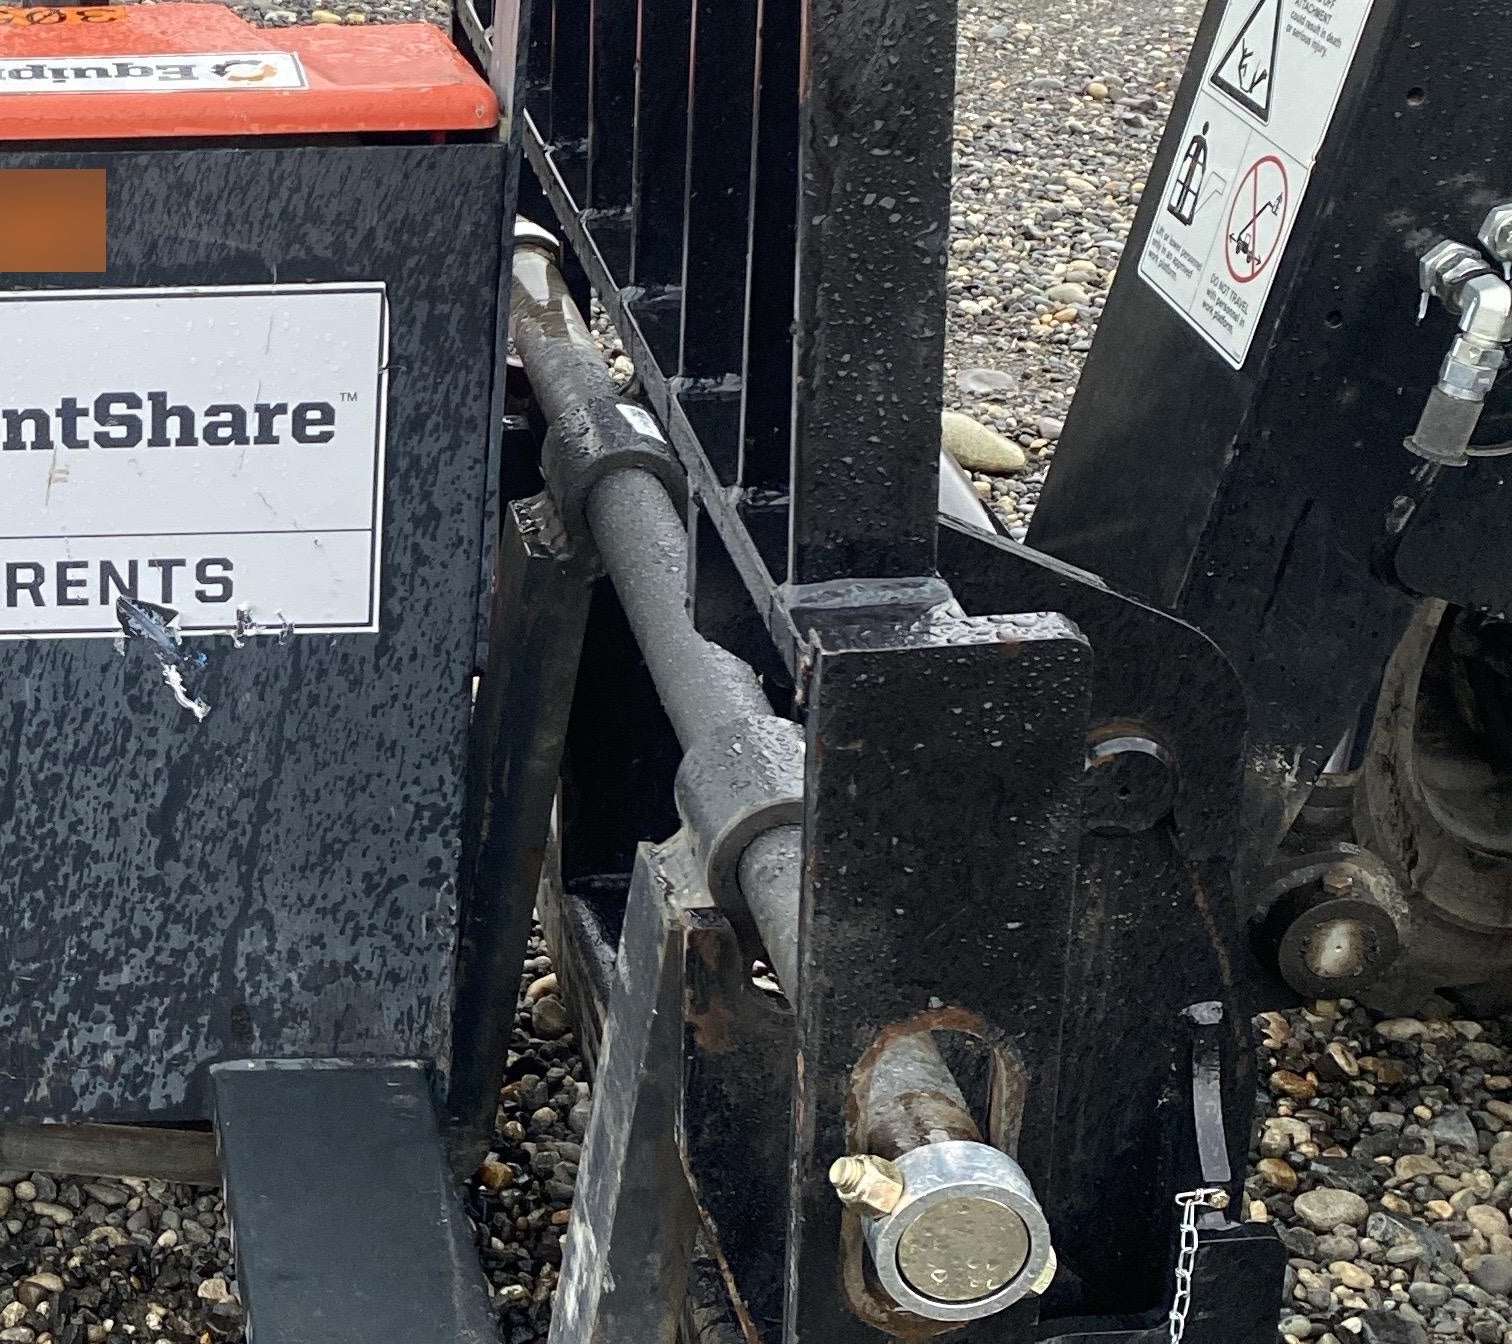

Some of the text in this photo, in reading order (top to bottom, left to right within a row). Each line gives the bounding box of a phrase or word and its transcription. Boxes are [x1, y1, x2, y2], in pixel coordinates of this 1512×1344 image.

[1286, 23, 1293, 32] or
[1292, 27, 1311, 46] serious
[1290, 10, 1342, 48] could result in death
[1210, 273, 1249, 316] DO NOT TRAVEL
